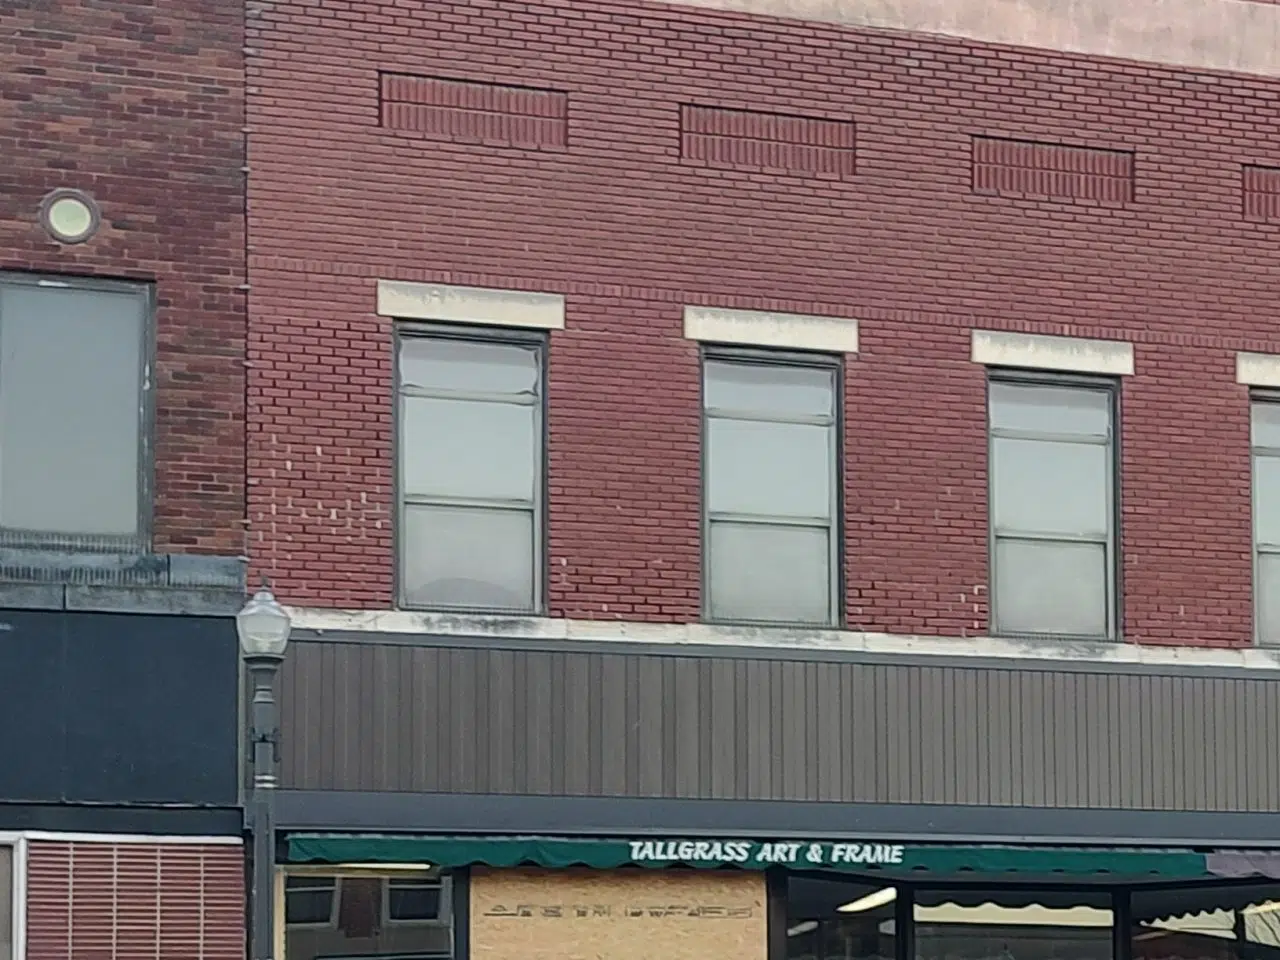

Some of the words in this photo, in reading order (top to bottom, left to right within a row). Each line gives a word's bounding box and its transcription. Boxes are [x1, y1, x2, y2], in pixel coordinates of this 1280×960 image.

[629, 841, 752, 862] TALLGRASS
[756, 842, 801, 863] ART
[805, 844, 824, 864] &
[831, 844, 904, 864] FRAME
